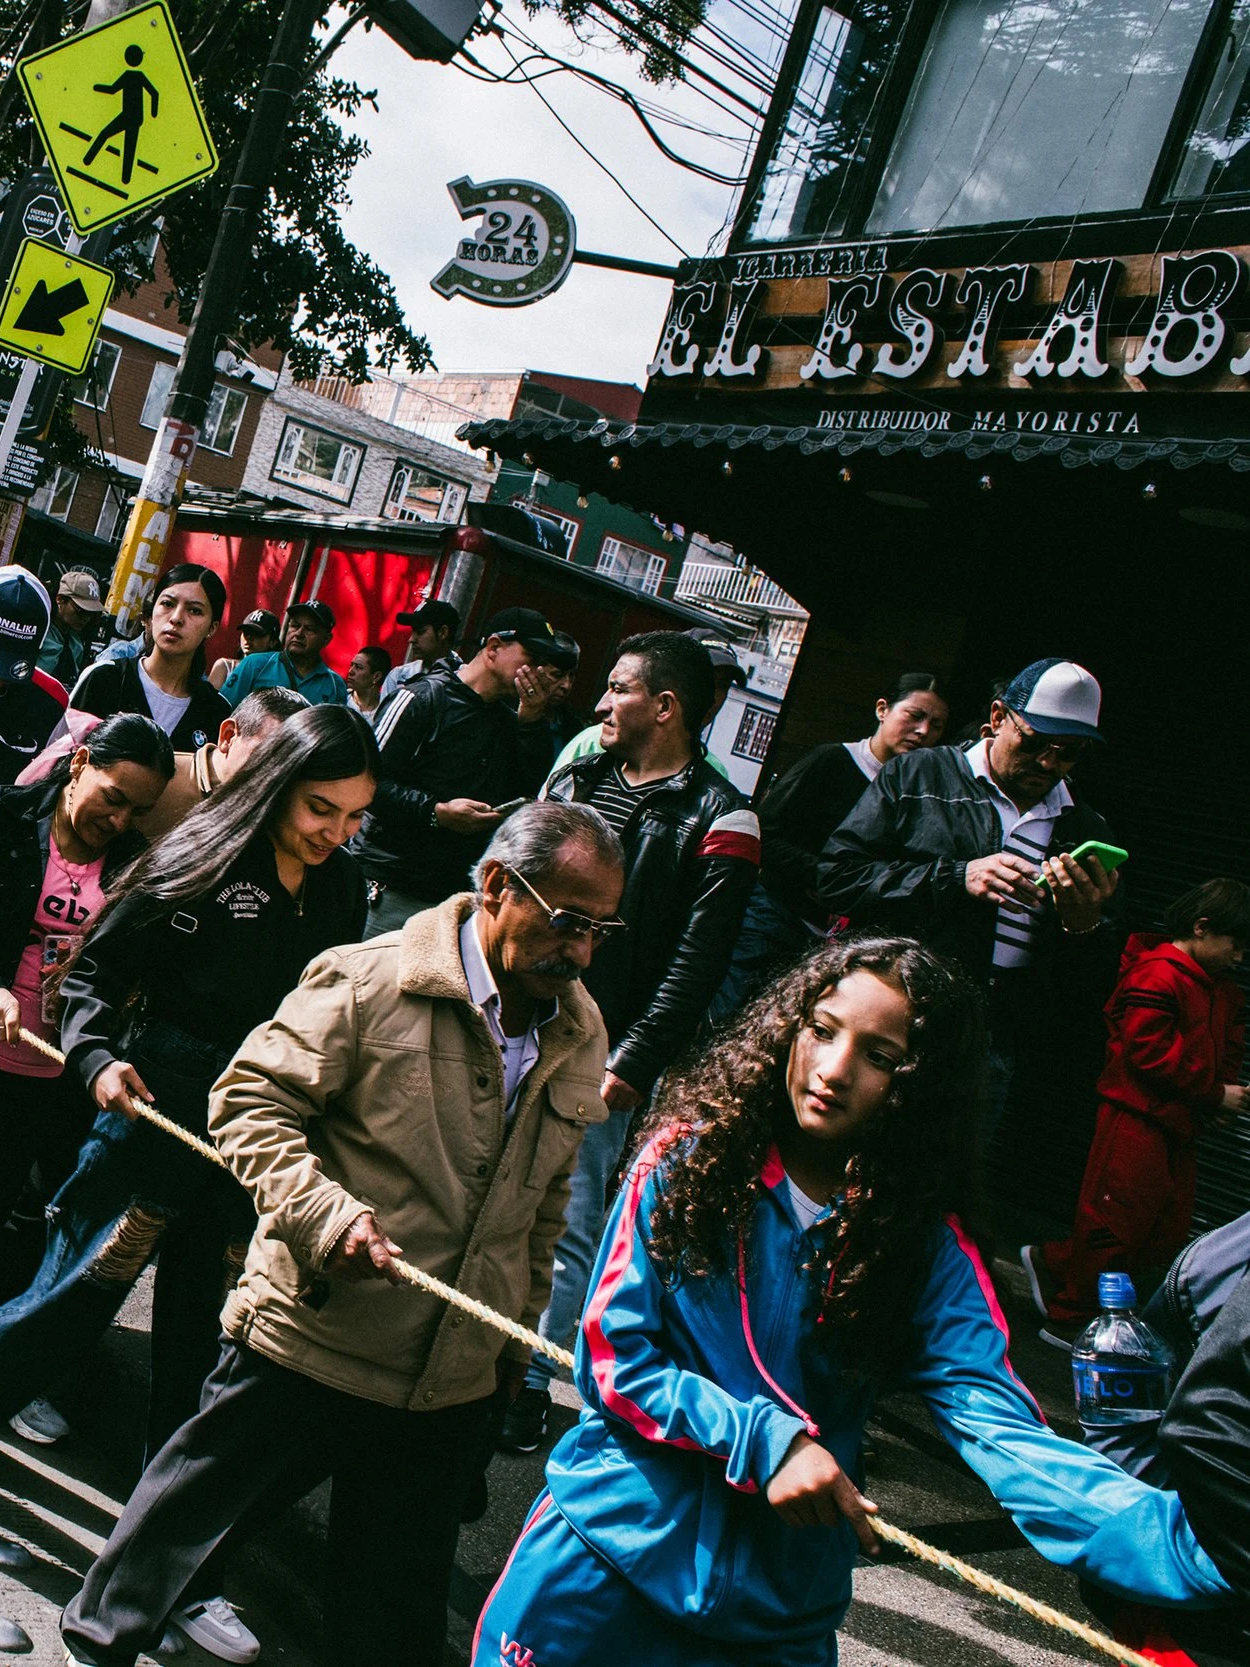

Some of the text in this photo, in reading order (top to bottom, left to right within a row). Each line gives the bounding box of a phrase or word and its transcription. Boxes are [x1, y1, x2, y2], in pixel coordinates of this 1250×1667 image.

[485, 211, 538, 248] 24
[459, 241, 539, 266] HORAS
[647, 250, 1250, 379] EL ESTAB
[814, 408, 1141, 434] DISTRIBUIDOR MAYORISTA
[215, 887, 231, 903] THE
[230, 880, 252, 892] LOLA
